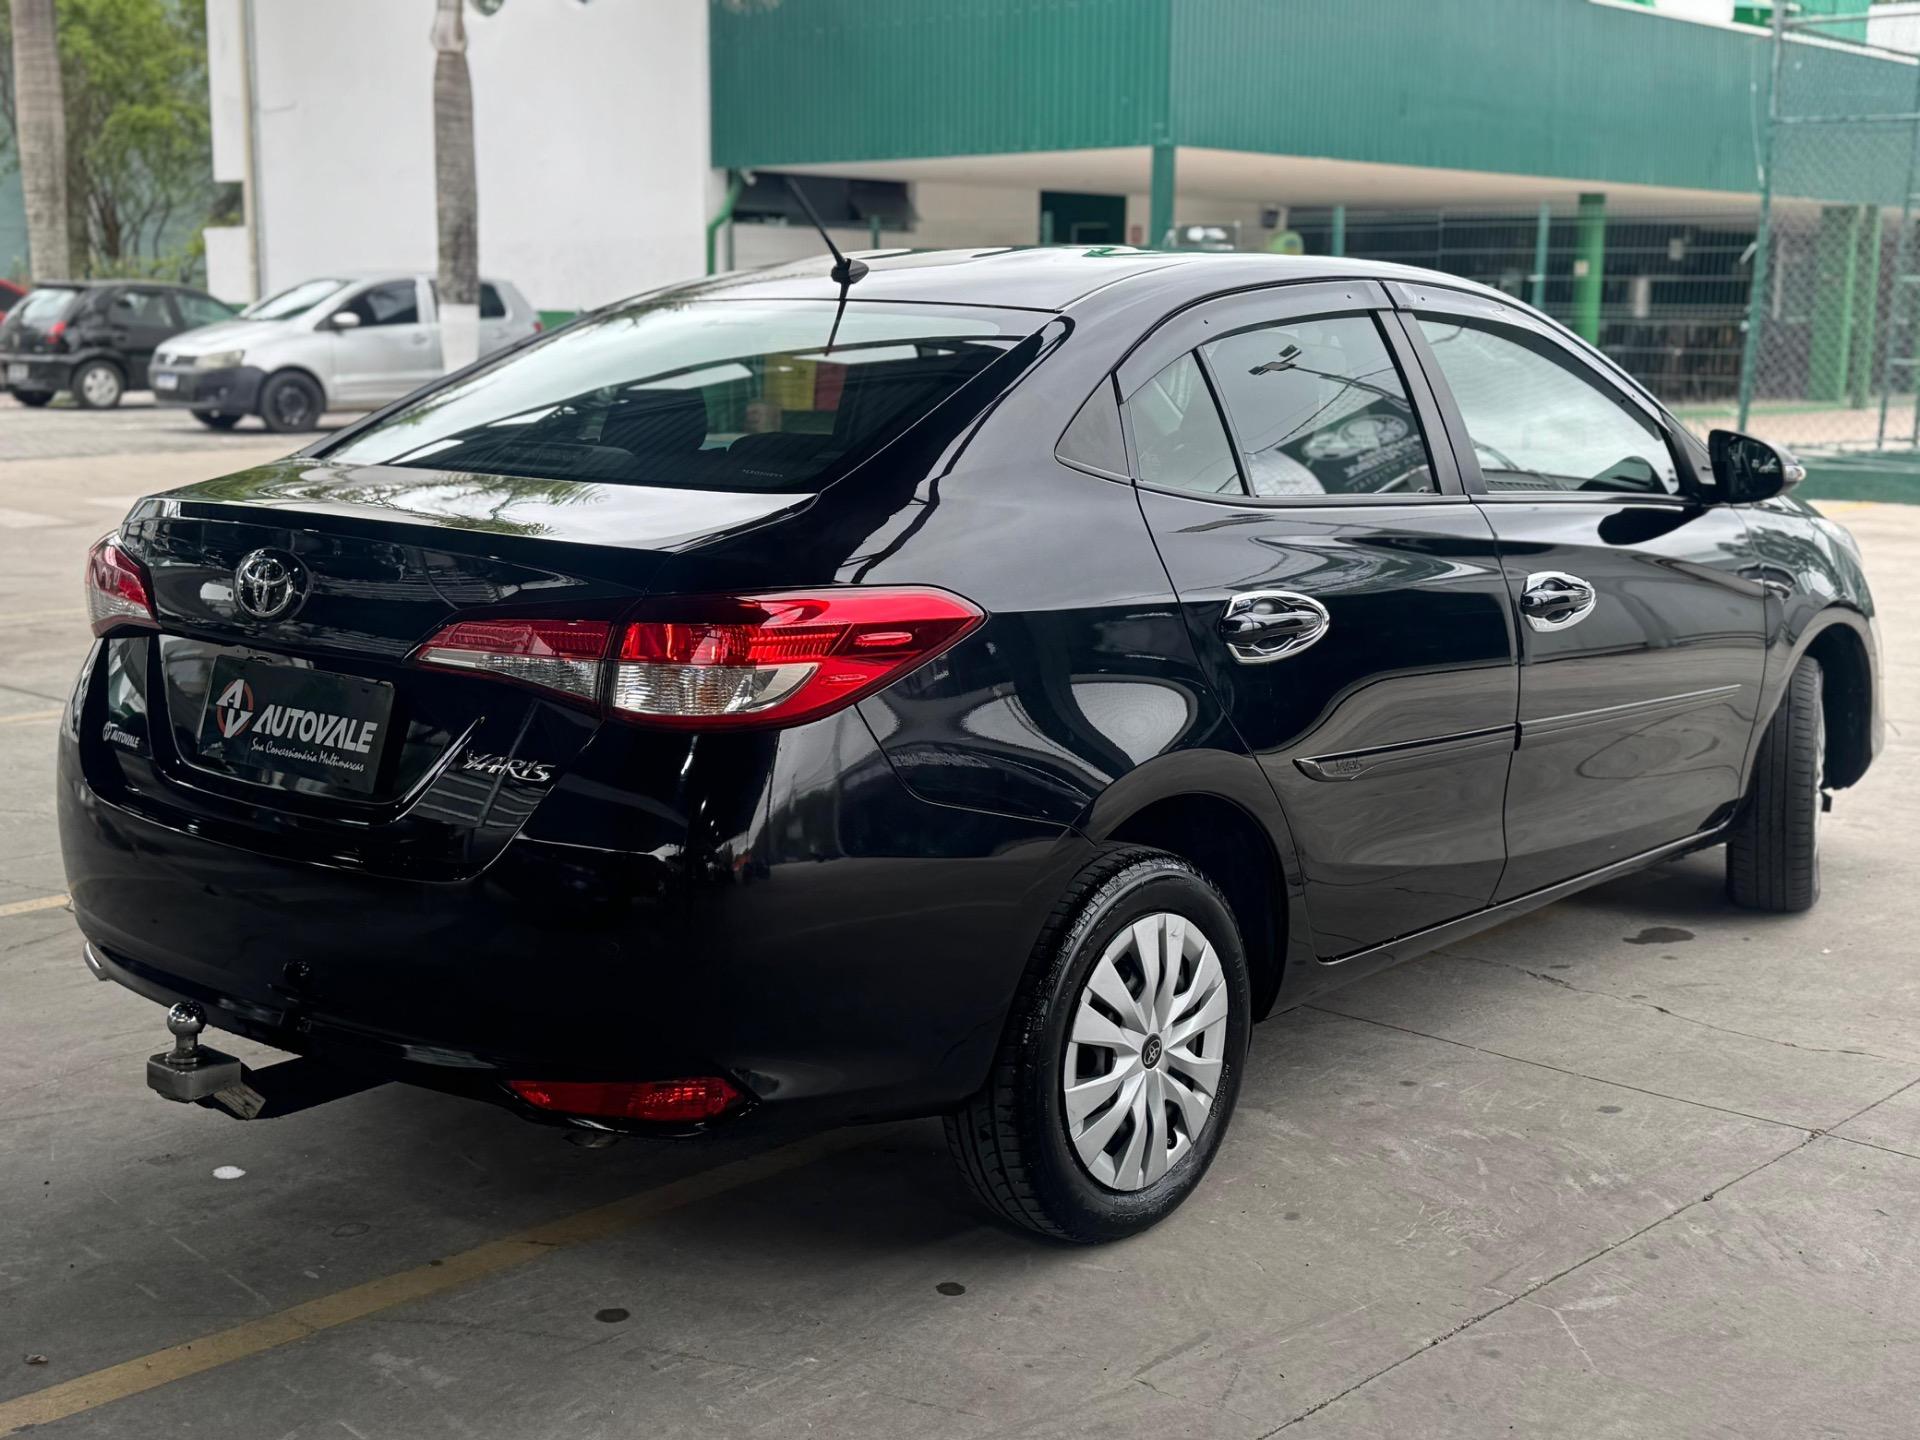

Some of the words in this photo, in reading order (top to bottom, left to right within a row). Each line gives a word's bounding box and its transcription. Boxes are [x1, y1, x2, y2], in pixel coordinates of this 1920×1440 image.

[110, 730, 140, 748] AUTOVALE
[252, 704, 378, 753] AUTOVALE
[251, 737, 265, 753] Sua
[319, 750, 365, 772] Multimarcas
[462, 749, 556, 781] YARIS
